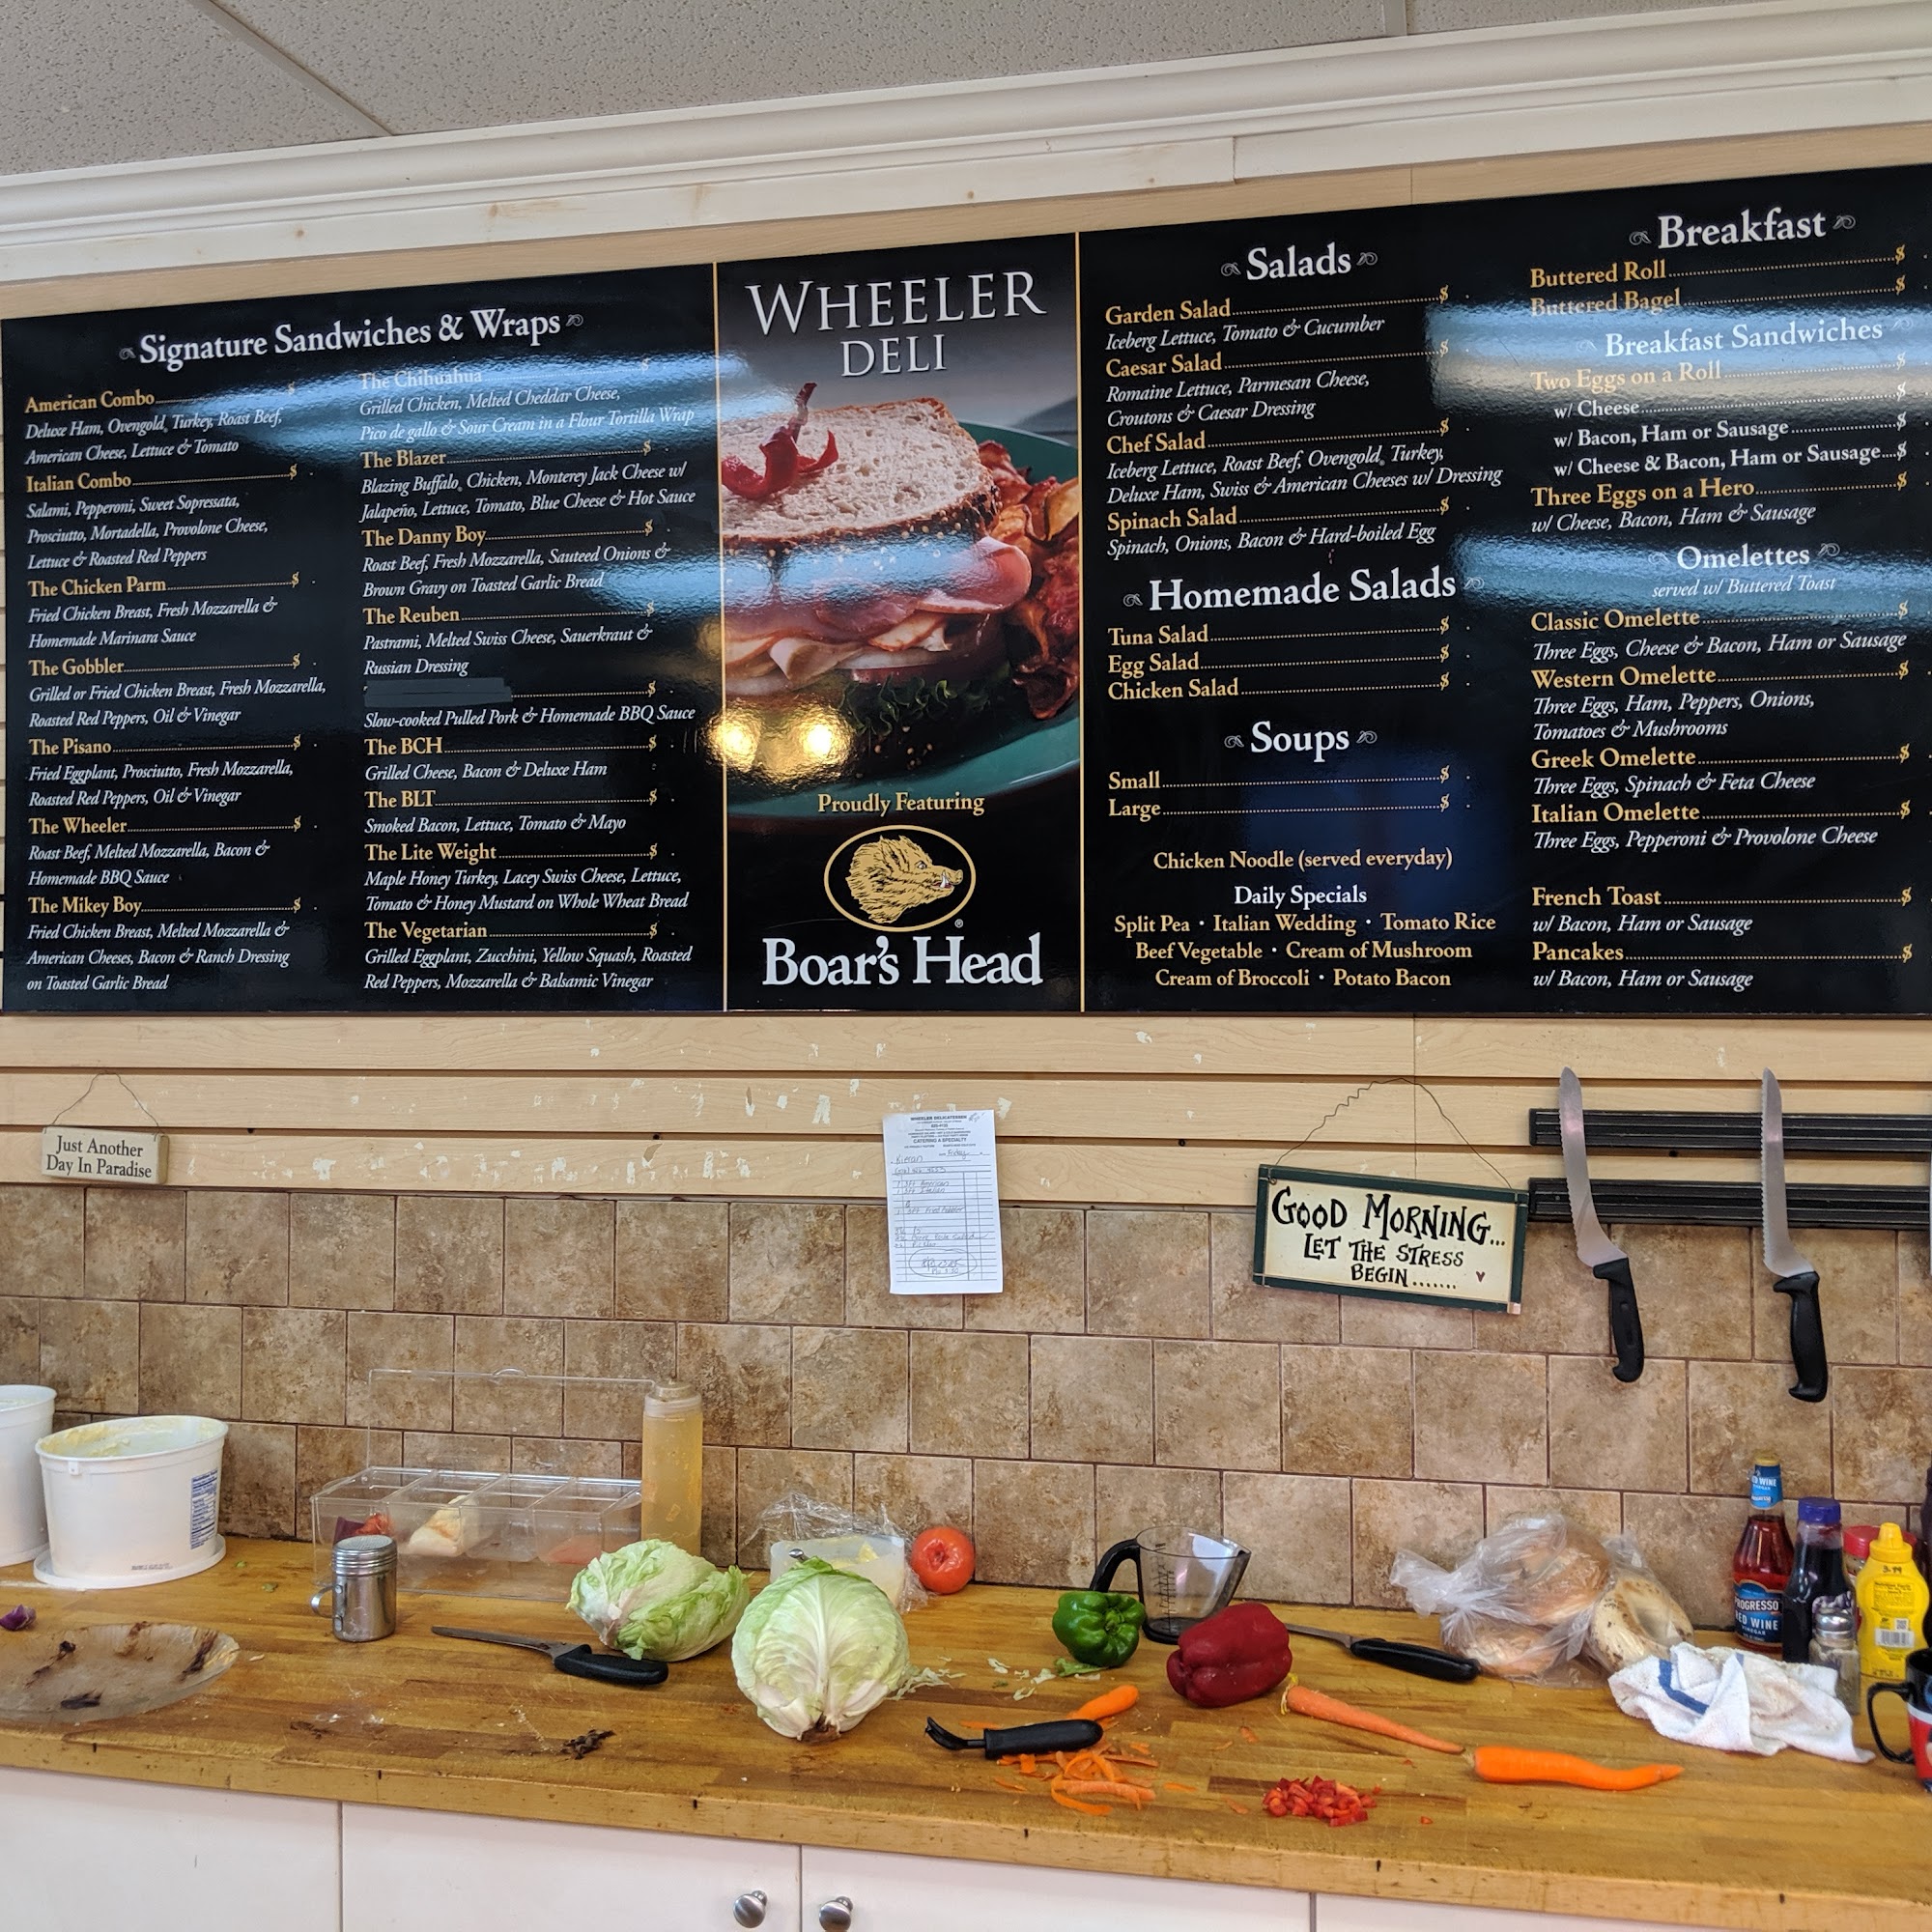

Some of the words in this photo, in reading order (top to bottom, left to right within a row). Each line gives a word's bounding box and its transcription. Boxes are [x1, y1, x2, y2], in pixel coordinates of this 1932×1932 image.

[1659, 207, 1826, 248] Breakfast
[1247, 242, 1350, 280] Salads
[1531, 263, 1618, 288] Buttered
[1624, 259, 1665, 281] Roll
[745, 270, 1047, 335] WHEELER
[1105, 303, 1175, 325] Garden
[1180, 298, 1231, 319] Salad
[140, 334, 267, 370] Signature
[274, 317, 431, 353] Sandwiches
[439, 314, 463, 341] &
[470, 309, 560, 346] Wraps
[1106, 331, 1157, 353] Iceberg
[1160, 329, 1215, 346] Lettuce,
[1223, 325, 1278, 341] Tomato
[1283, 319, 1301, 337] &
[1304, 314, 1384, 335] Cucumber
[1605, 327, 1725, 357] Breakfast
[1731, 317, 1883, 350] Sandwiches
[840, 334, 947, 377] DELI
[1106, 358, 1166, 377] Caesar
[1172, 352, 1222, 373] Salad
[25, 394, 97, 412] American
[100, 389, 155, 408] Combo
[1554, 403, 1573, 418] w/
[1577, 400, 1639, 416] Cheese
[1107, 434, 1152, 454] Chef
[1155, 430, 1206, 451] Salad
[1553, 432, 1573, 447] w/
[1577, 429, 1636, 446] Bacon,
[1641, 425, 1687, 442] Ham
[1692, 428, 1712, 439] or
[1717, 420, 1788, 440] Sausage
[360, 451, 392, 469] The
[397, 450, 446, 467] Blazer
[27, 475, 74, 492] Italian
[77, 471, 131, 489] Combo
[1530, 487, 1591, 506] Three
[1597, 484, 1646, 509] Eggs
[1652, 488, 1677, 499] on
[1684, 487, 1693, 498] a
[1700, 477, 1754, 497] Hero
[27, 502, 71, 518] Salami,
[75, 499, 135, 520] Pepperoni,
[139, 497, 175, 512] Sweet
[177, 495, 240, 514] Sopressata,
[1108, 509, 1181, 537] Spinach
[1187, 505, 1236, 526] Salad
[361, 529, 394, 547] The
[398, 528, 451, 548] Danny
[456, 526, 488, 547] Boy
[1676, 544, 1810, 572] Omelettes
[28, 581, 58, 596] The
[62, 579, 123, 595] Chicken
[127, 576, 166, 592] Parm
[1150, 571, 1339, 611] Homemade
[1350, 565, 1456, 601] Salads
[363, 608, 395, 624] The
[400, 606, 460, 623] Reuben
[1531, 611, 1599, 631] Classic
[1605, 608, 1700, 628] Omelette
[1108, 628, 1153, 645] Tuna
[1158, 624, 1208, 643] Salad
[29, 660, 58, 675] The
[63, 658, 128, 674] Gobbler
[1108, 655, 1145, 679] Egg
[1150, 651, 1199, 671] Salad
[1108, 681, 1183, 699] Chicken
[1188, 677, 1238, 696] Salad
[1531, 669, 1613, 689] Western
[1620, 665, 1716, 685] Omelette
[364, 710, 442, 727] Slow-cooked
[444, 709, 486, 725] Pulled
[488, 708, 519, 724] Pork
[522, 707, 538, 723] &
[539, 705, 615, 723] Homemade
[618, 705, 654, 724] BBQ
[657, 704, 696, 720] Sauce
[29, 739, 59, 754] The
[63, 738, 111, 753] Pisano
[364, 739, 396, 754] The
[401, 737, 442, 754] BCH
[1251, 721, 1350, 762] Soups
[1531, 749, 1594, 768] Greek
[1600, 747, 1695, 767] Omelette
[1109, 771, 1160, 789] Small
[364, 791, 397, 808] The
[402, 790, 438, 807] BLT
[818, 793, 891, 817] Proudly
[895, 792, 985, 816] Featuring
[1109, 799, 1160, 822] Large
[1532, 804, 1598, 822] Italian
[1604, 802, 1699, 821] Omelette
[29, 818, 59, 834] The
[63, 816, 127, 833] Wheeler
[365, 844, 397, 861] The
[401, 843, 433, 860] Lite
[437, 842, 497, 865] Weight
[1153, 852, 1225, 868] Chicken
[1230, 850, 1293, 867] Noodle
[1298, 849, 1361, 871] (served
[1366, 847, 1452, 870] everyday)
[28, 897, 58, 913] The
[63, 896, 109, 918] Mikey
[113, 896, 143, 917] Boy
[1235, 886, 1286, 909] Daily
[1291, 885, 1367, 910] Specials
[1532, 887, 1602, 905] French
[1607, 886, 1662, 905] Toast
[364, 922, 397, 938] The
[401, 922, 487, 944] Vegetarian
[1115, 916, 1155, 938] Split
[1160, 915, 1190, 931] Pea
[1213, 915, 1270, 931] Italian
[1275, 914, 1356, 936] Wedding
[1380, 913, 1449, 930] Tomato
[1455, 912, 1495, 929] Rice
[762, 935, 899, 985] Boar's
[913, 932, 1043, 985] Head
[1533, 941, 1624, 960] Pancakes
[27, 980, 42, 990] on
[46, 975, 90, 990] Toasted
[92, 975, 129, 990] Garlic
[131, 974, 169, 989] Bread
[56, 1135, 83, 1154] Just
[87, 1138, 144, 1157] Another
[46, 1154, 73, 1176] Day
[77, 1156, 92, 1174] In
[97, 1158, 152, 1178] Paradise
[1271, 1186, 1348, 1230] GOOD
[1304, 1233, 1341, 1260] LET
[1349, 1239, 1385, 1263] THE
[1396, 1243, 1463, 1267] STRESS
[1750, 1617, 1778, 1632] WINE
